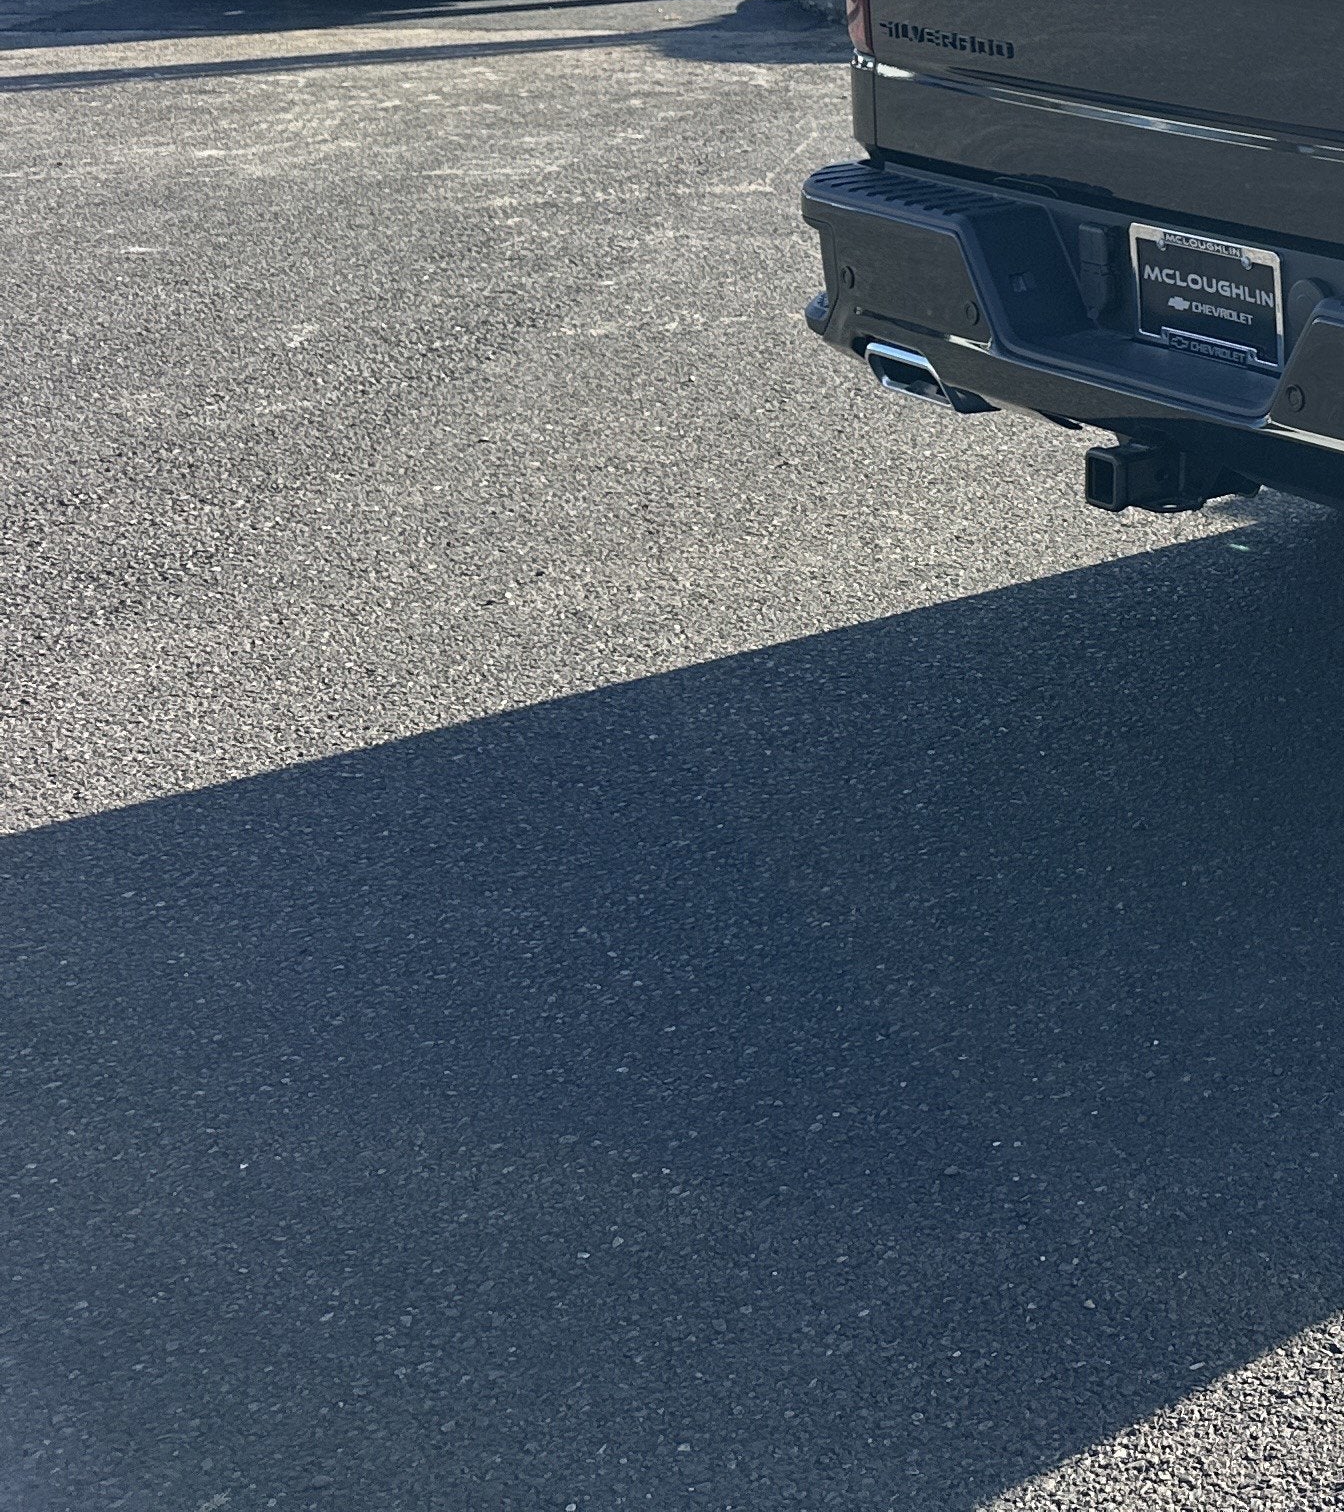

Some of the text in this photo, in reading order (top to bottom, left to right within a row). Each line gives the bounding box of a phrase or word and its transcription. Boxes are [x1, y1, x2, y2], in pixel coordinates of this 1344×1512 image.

[879, 20, 1016, 59] SILVERADO
[1165, 233, 1241, 258] MCLOUGHLIN
[1143, 264, 1275, 308] MCLOUGHLIN
[1191, 301, 1254, 326] CHEVROLET
[1190, 341, 1246, 363] CHEVROLET
